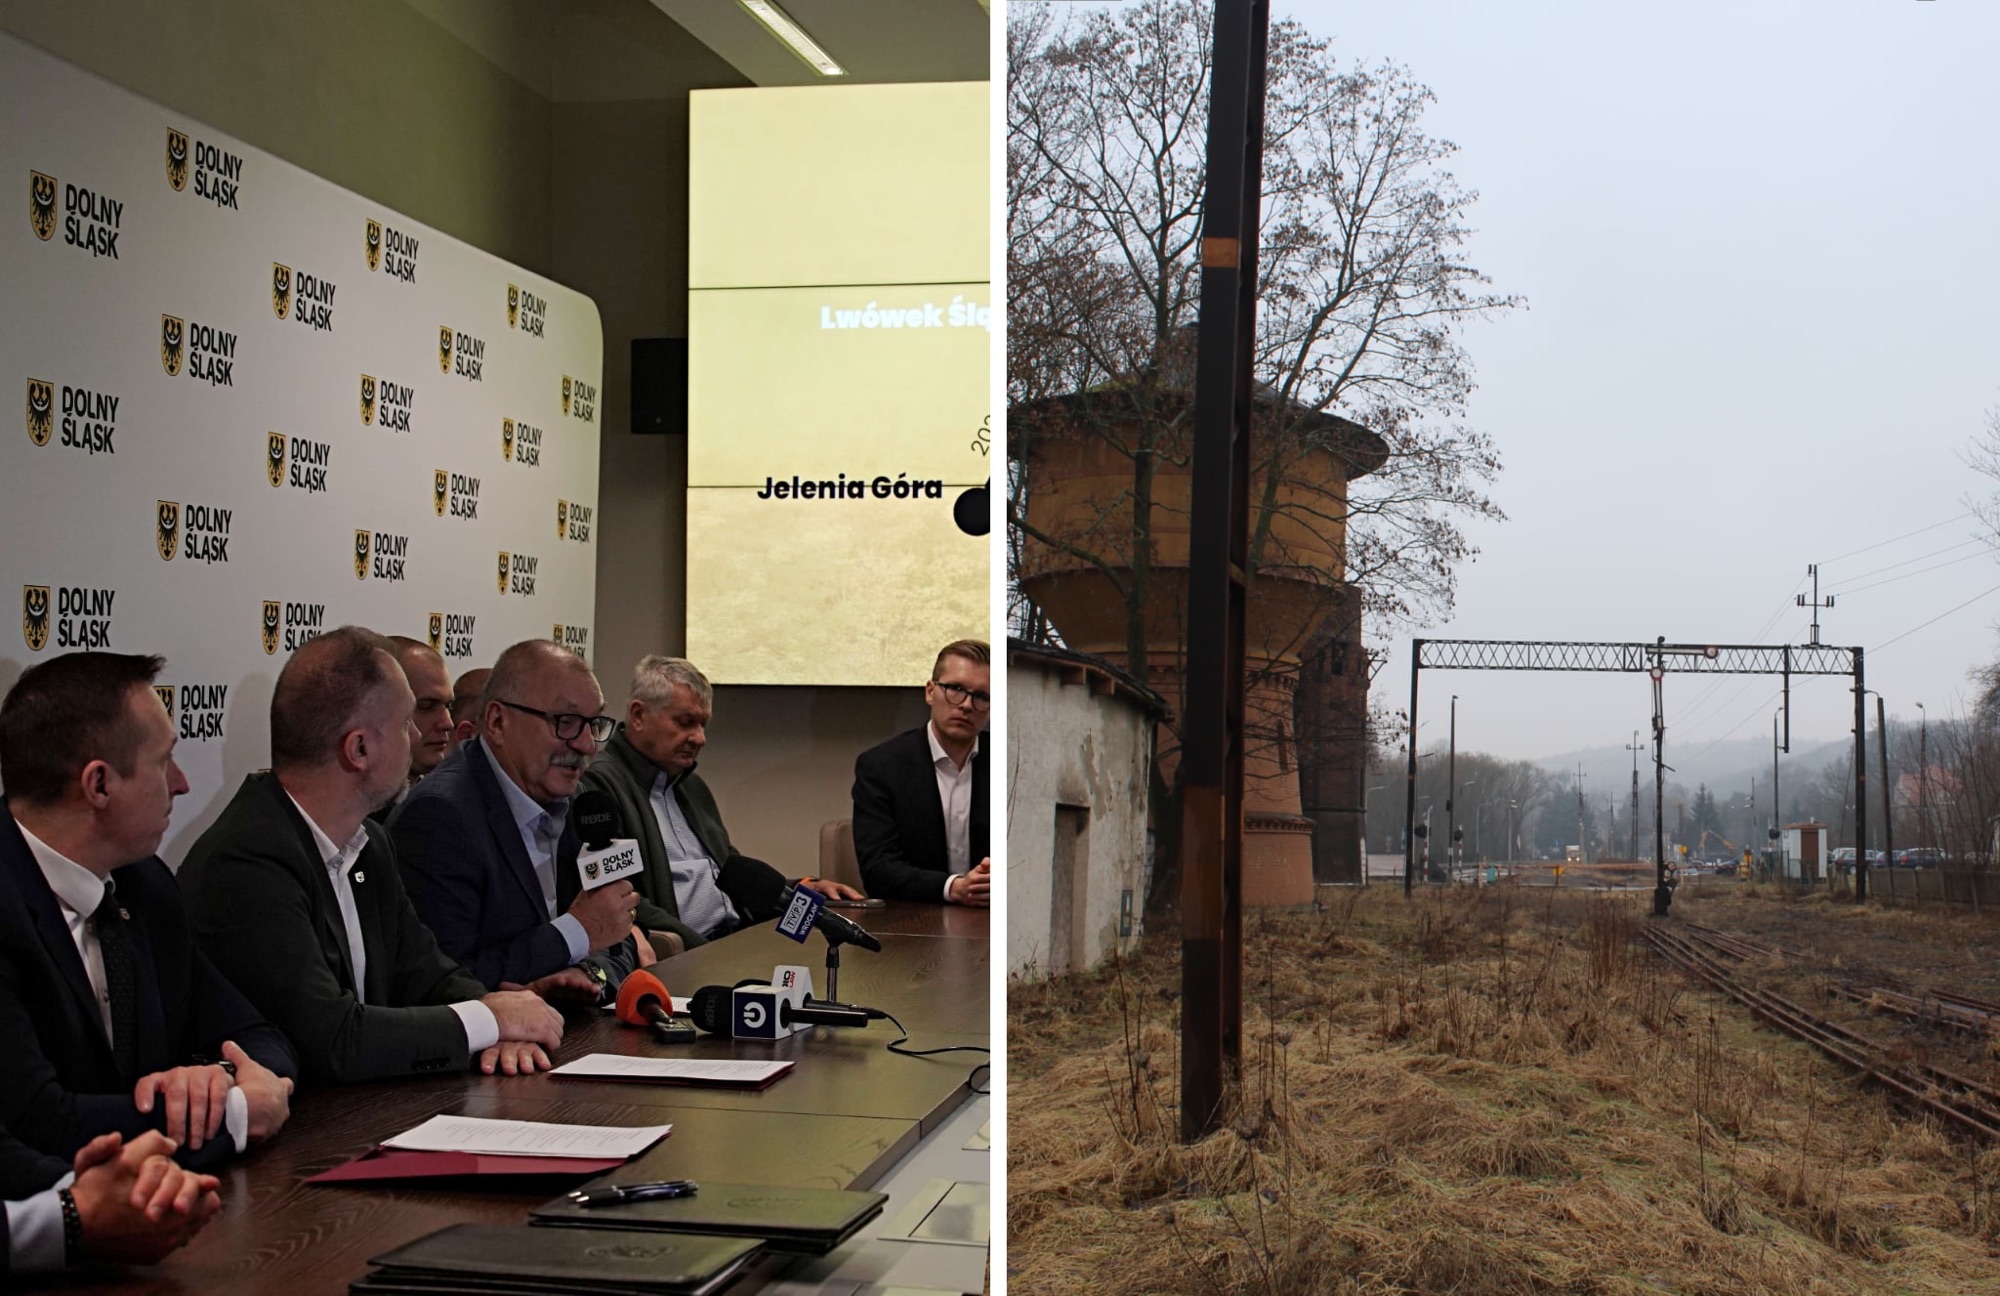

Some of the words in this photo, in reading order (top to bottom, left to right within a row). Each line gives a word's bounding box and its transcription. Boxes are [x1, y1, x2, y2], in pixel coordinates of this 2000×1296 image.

[195, 141, 243, 182] DOLNY
[194, 164, 239, 210] ŚLĄSK
[65, 184, 123, 229] DOLNY
[64, 210, 119, 260] ŚLĄSK
[385, 227, 419, 261] DOLNY
[384, 248, 416, 284] ŚLĄSK
[296, 271, 336, 307] DOLNY
[521, 290, 547, 317] DOLNY
[295, 291, 333, 332] ŚLĄSK
[520, 306, 545, 339] ŚLĄSK
[820, 301, 943, 329] Lwówek
[190, 323, 237, 359] DOLNY
[456, 331, 485, 361] DOLNY
[189, 346, 233, 387] ŚLĄSK
[455, 350, 483, 382] ŚLĄSK
[62, 386, 119, 423] DOLNY
[381, 380, 414, 410] DOLNY
[574, 379, 597, 405] DOLNY
[379, 398, 411, 433] ŚLĄSK
[573, 396, 595, 424] ŚLĄSK
[61, 411, 115, 455] ŚLĄSK
[517, 421, 543, 447] DOLNY
[291, 436, 330, 467] DOLNY
[516, 438, 540, 468] ŚLĄSK
[290, 457, 327, 493] ŚLĄSK
[451, 473, 481, 499] DOLNY
[757, 473, 865, 500] Jelenia
[871, 472, 943, 500] Góra
[186, 504, 232, 534] DOLNY
[450, 491, 478, 521] ŚLĄSK
[570, 502, 593, 525] DOLNY
[184, 526, 228, 565] ŚLĄSK
[374, 532, 409, 557] DOLNY
[569, 518, 590, 544] ŚLĄSK
[373, 551, 405, 583] ŚLĄSK
[512, 553, 538, 575] DOLNY
[511, 569, 536, 598] ŚLĄSK
[58, 587, 116, 616] DOLNY
[286, 602, 325, 627] DOLNY
[57, 612, 111, 651] ŚLĄSK
[446, 613, 476, 635] DOLNY
[566, 625, 588, 644] DOLNY
[445, 632, 473, 660] ŚLĄSK
[181, 684, 227, 710] DOLNY
[179, 708, 223, 742] ŚLĄSK
[602, 849, 634, 866] DOLNY
[784, 904, 804, 929] TVP
[796, 896, 808, 906] 3
